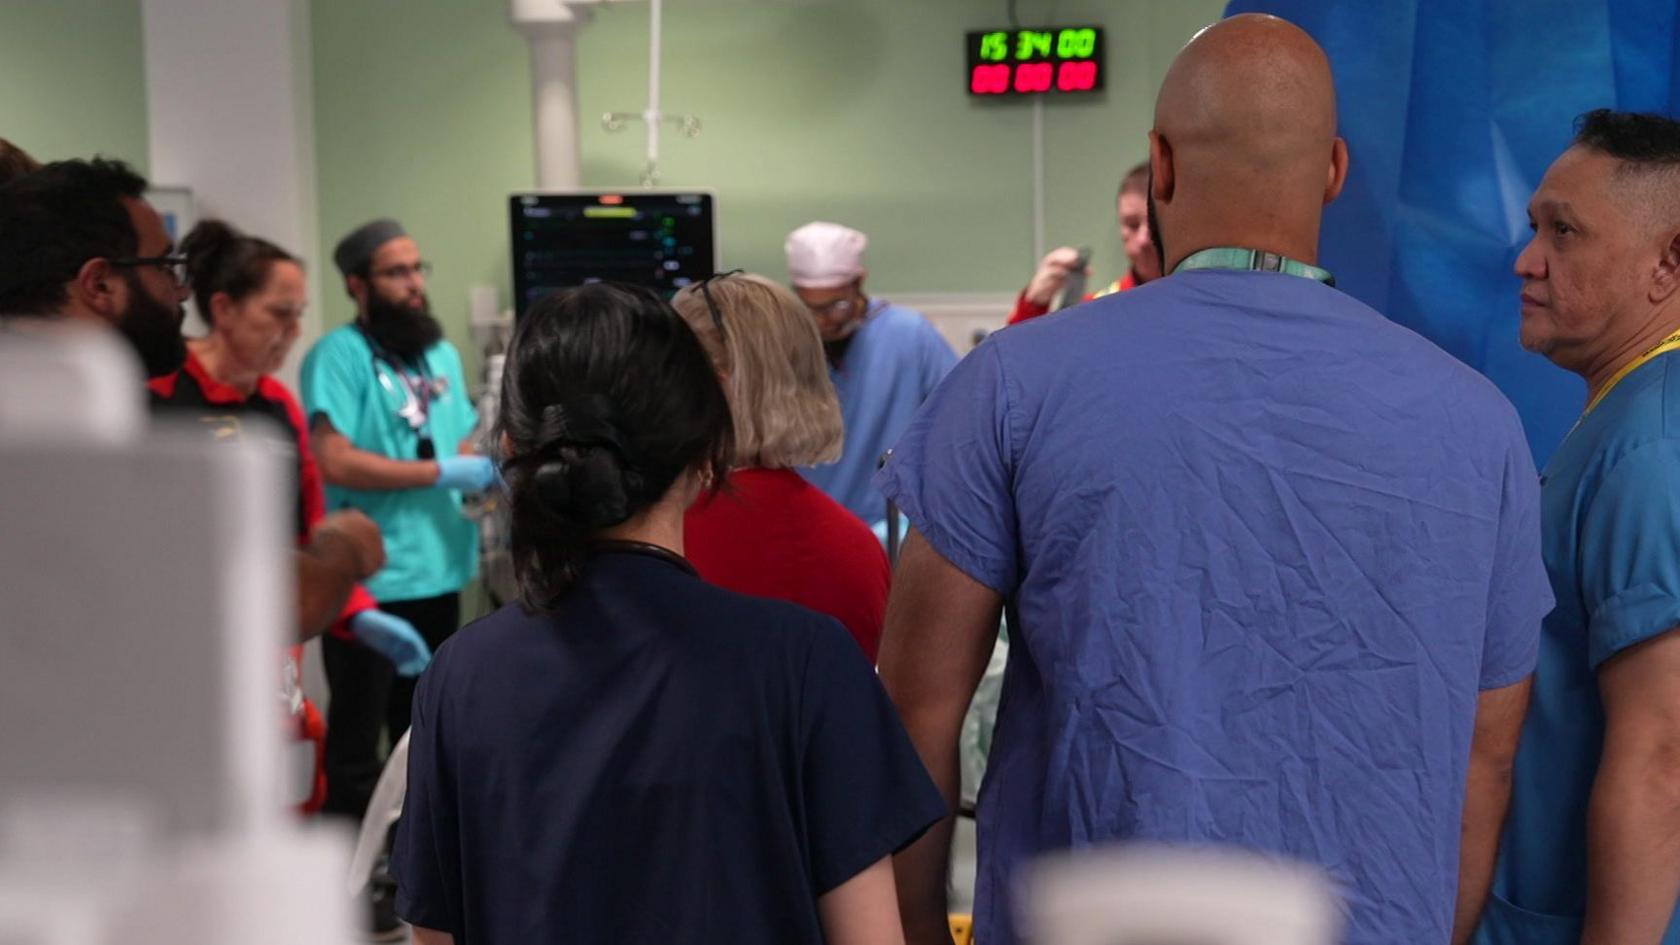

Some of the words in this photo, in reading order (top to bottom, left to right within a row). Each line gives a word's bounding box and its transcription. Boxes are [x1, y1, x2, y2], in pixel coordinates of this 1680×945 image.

[980, 31, 1008, 61] 15
[1014, 30, 1052, 60] 34
[1057, 28, 1096, 58] 00
